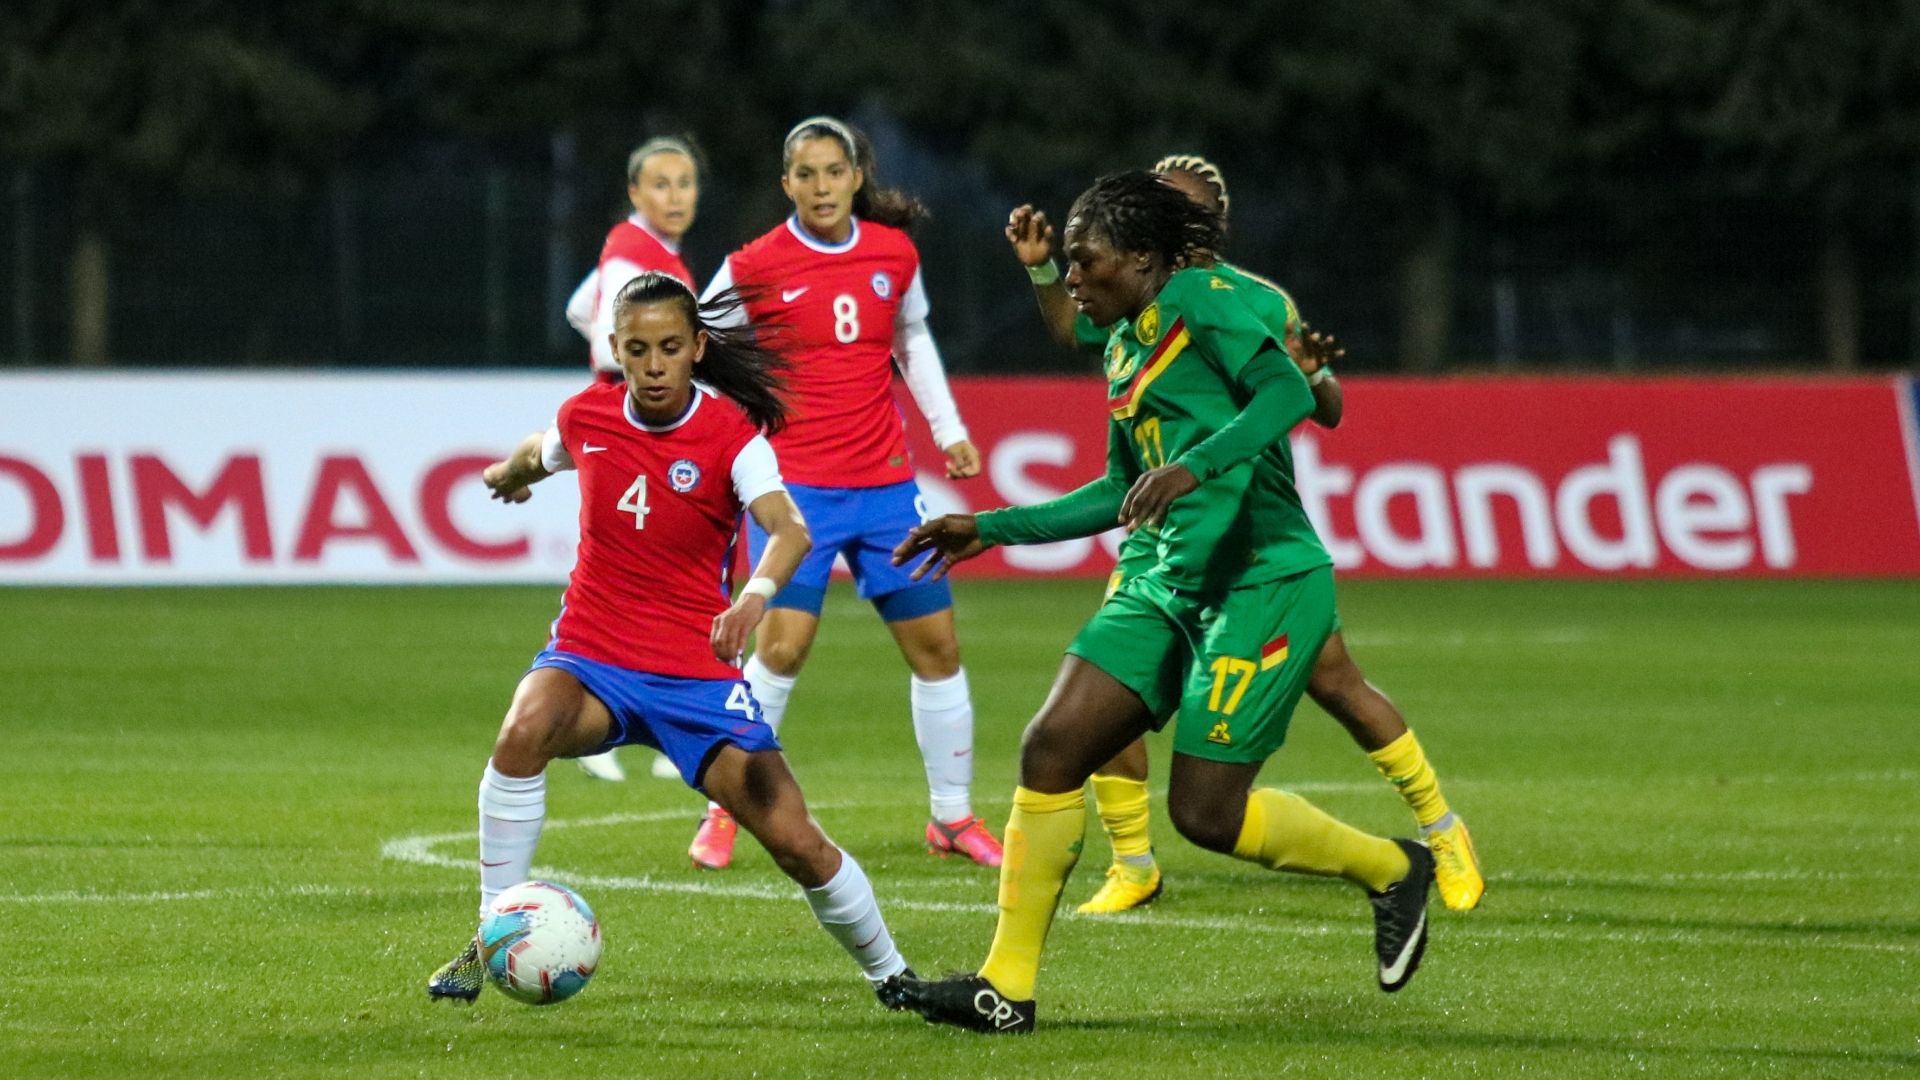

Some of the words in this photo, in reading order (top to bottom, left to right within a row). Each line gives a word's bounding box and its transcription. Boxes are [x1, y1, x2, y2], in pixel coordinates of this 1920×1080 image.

[832, 294, 860, 344] 8
[1134, 416, 1165, 470] 17
[617, 475, 650, 530] 4
[989, 432, 1812, 572] Stander
[725, 682, 754, 721] 4
[1207, 656, 1257, 716] 17
[974, 989, 1024, 1031] CR7
